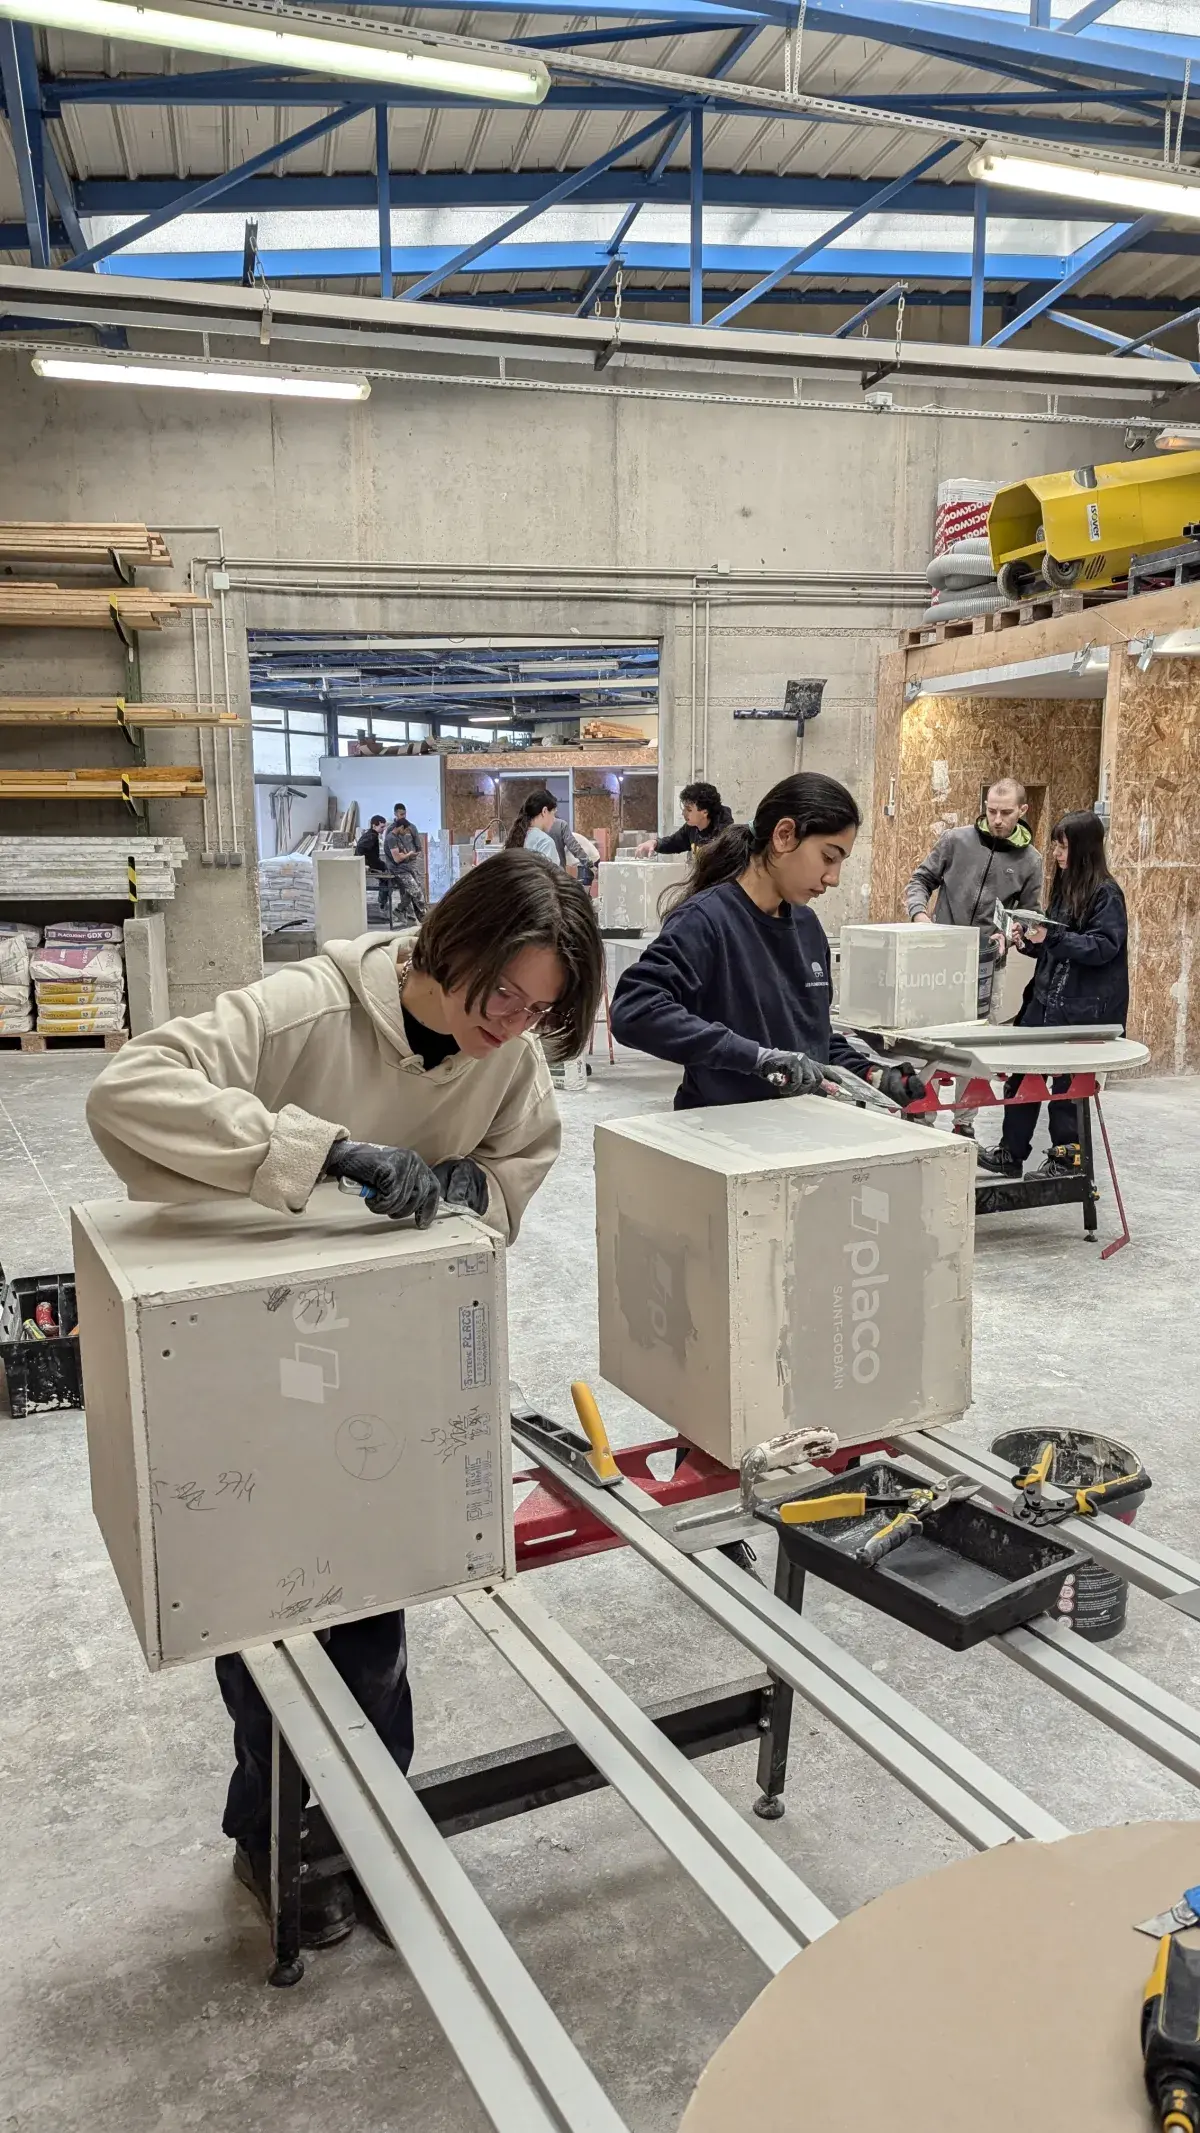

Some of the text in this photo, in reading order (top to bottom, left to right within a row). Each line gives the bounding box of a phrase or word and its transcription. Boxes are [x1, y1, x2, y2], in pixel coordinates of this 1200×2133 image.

[461, 1309, 473, 1348] PLACO
[832, 1284, 844, 1390] SAINT-GOBAIN
[843, 1240, 890, 1385] placo
[214, 1470, 256, 1503] 37,4
[465, 1450, 494, 1522] PLUME
